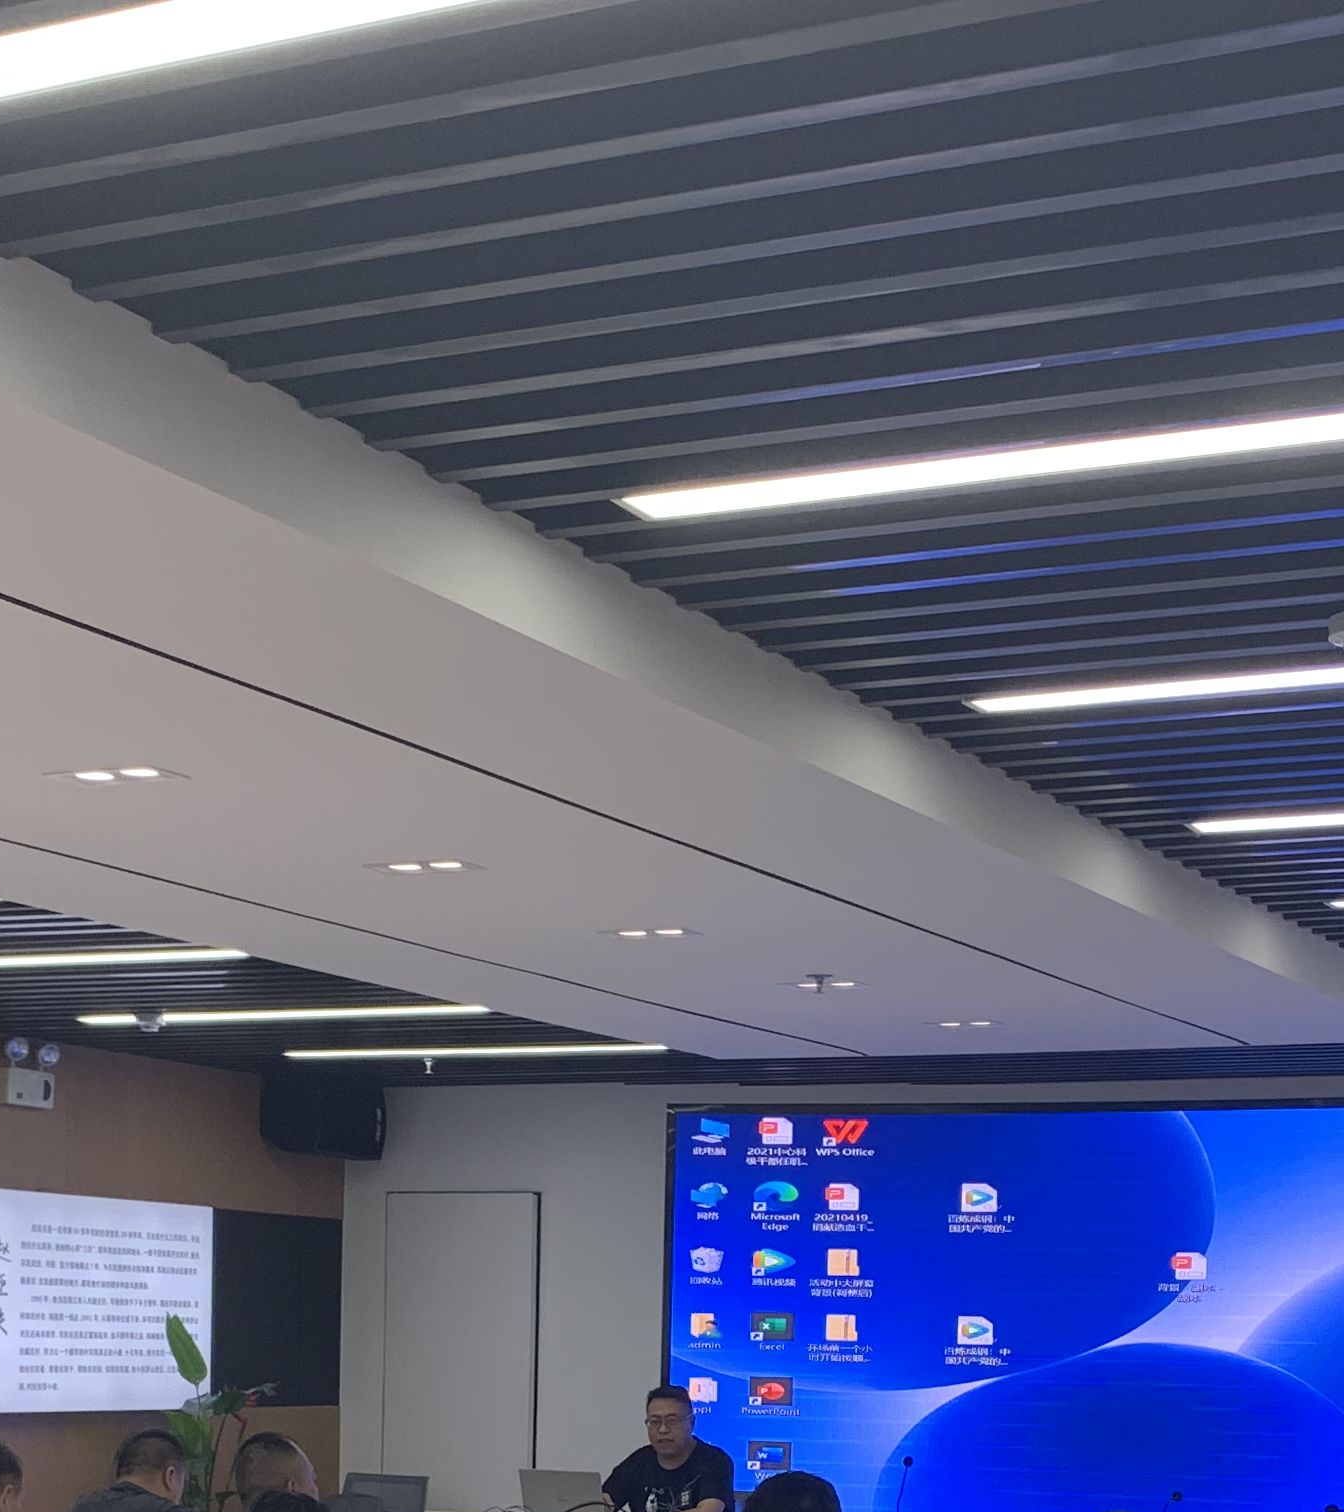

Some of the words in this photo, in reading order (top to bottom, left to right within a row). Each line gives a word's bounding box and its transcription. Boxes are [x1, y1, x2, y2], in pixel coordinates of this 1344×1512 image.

[815, 1148, 839, 1156] WPS
[842, 1148, 875, 1156] Office
[751, 1212, 800, 1221] Microsoft
[762, 1222, 789, 1232] Edge
[760, 1343, 784, 1351] Excel
[741, 1406, 800, 1416] PowerPoint
